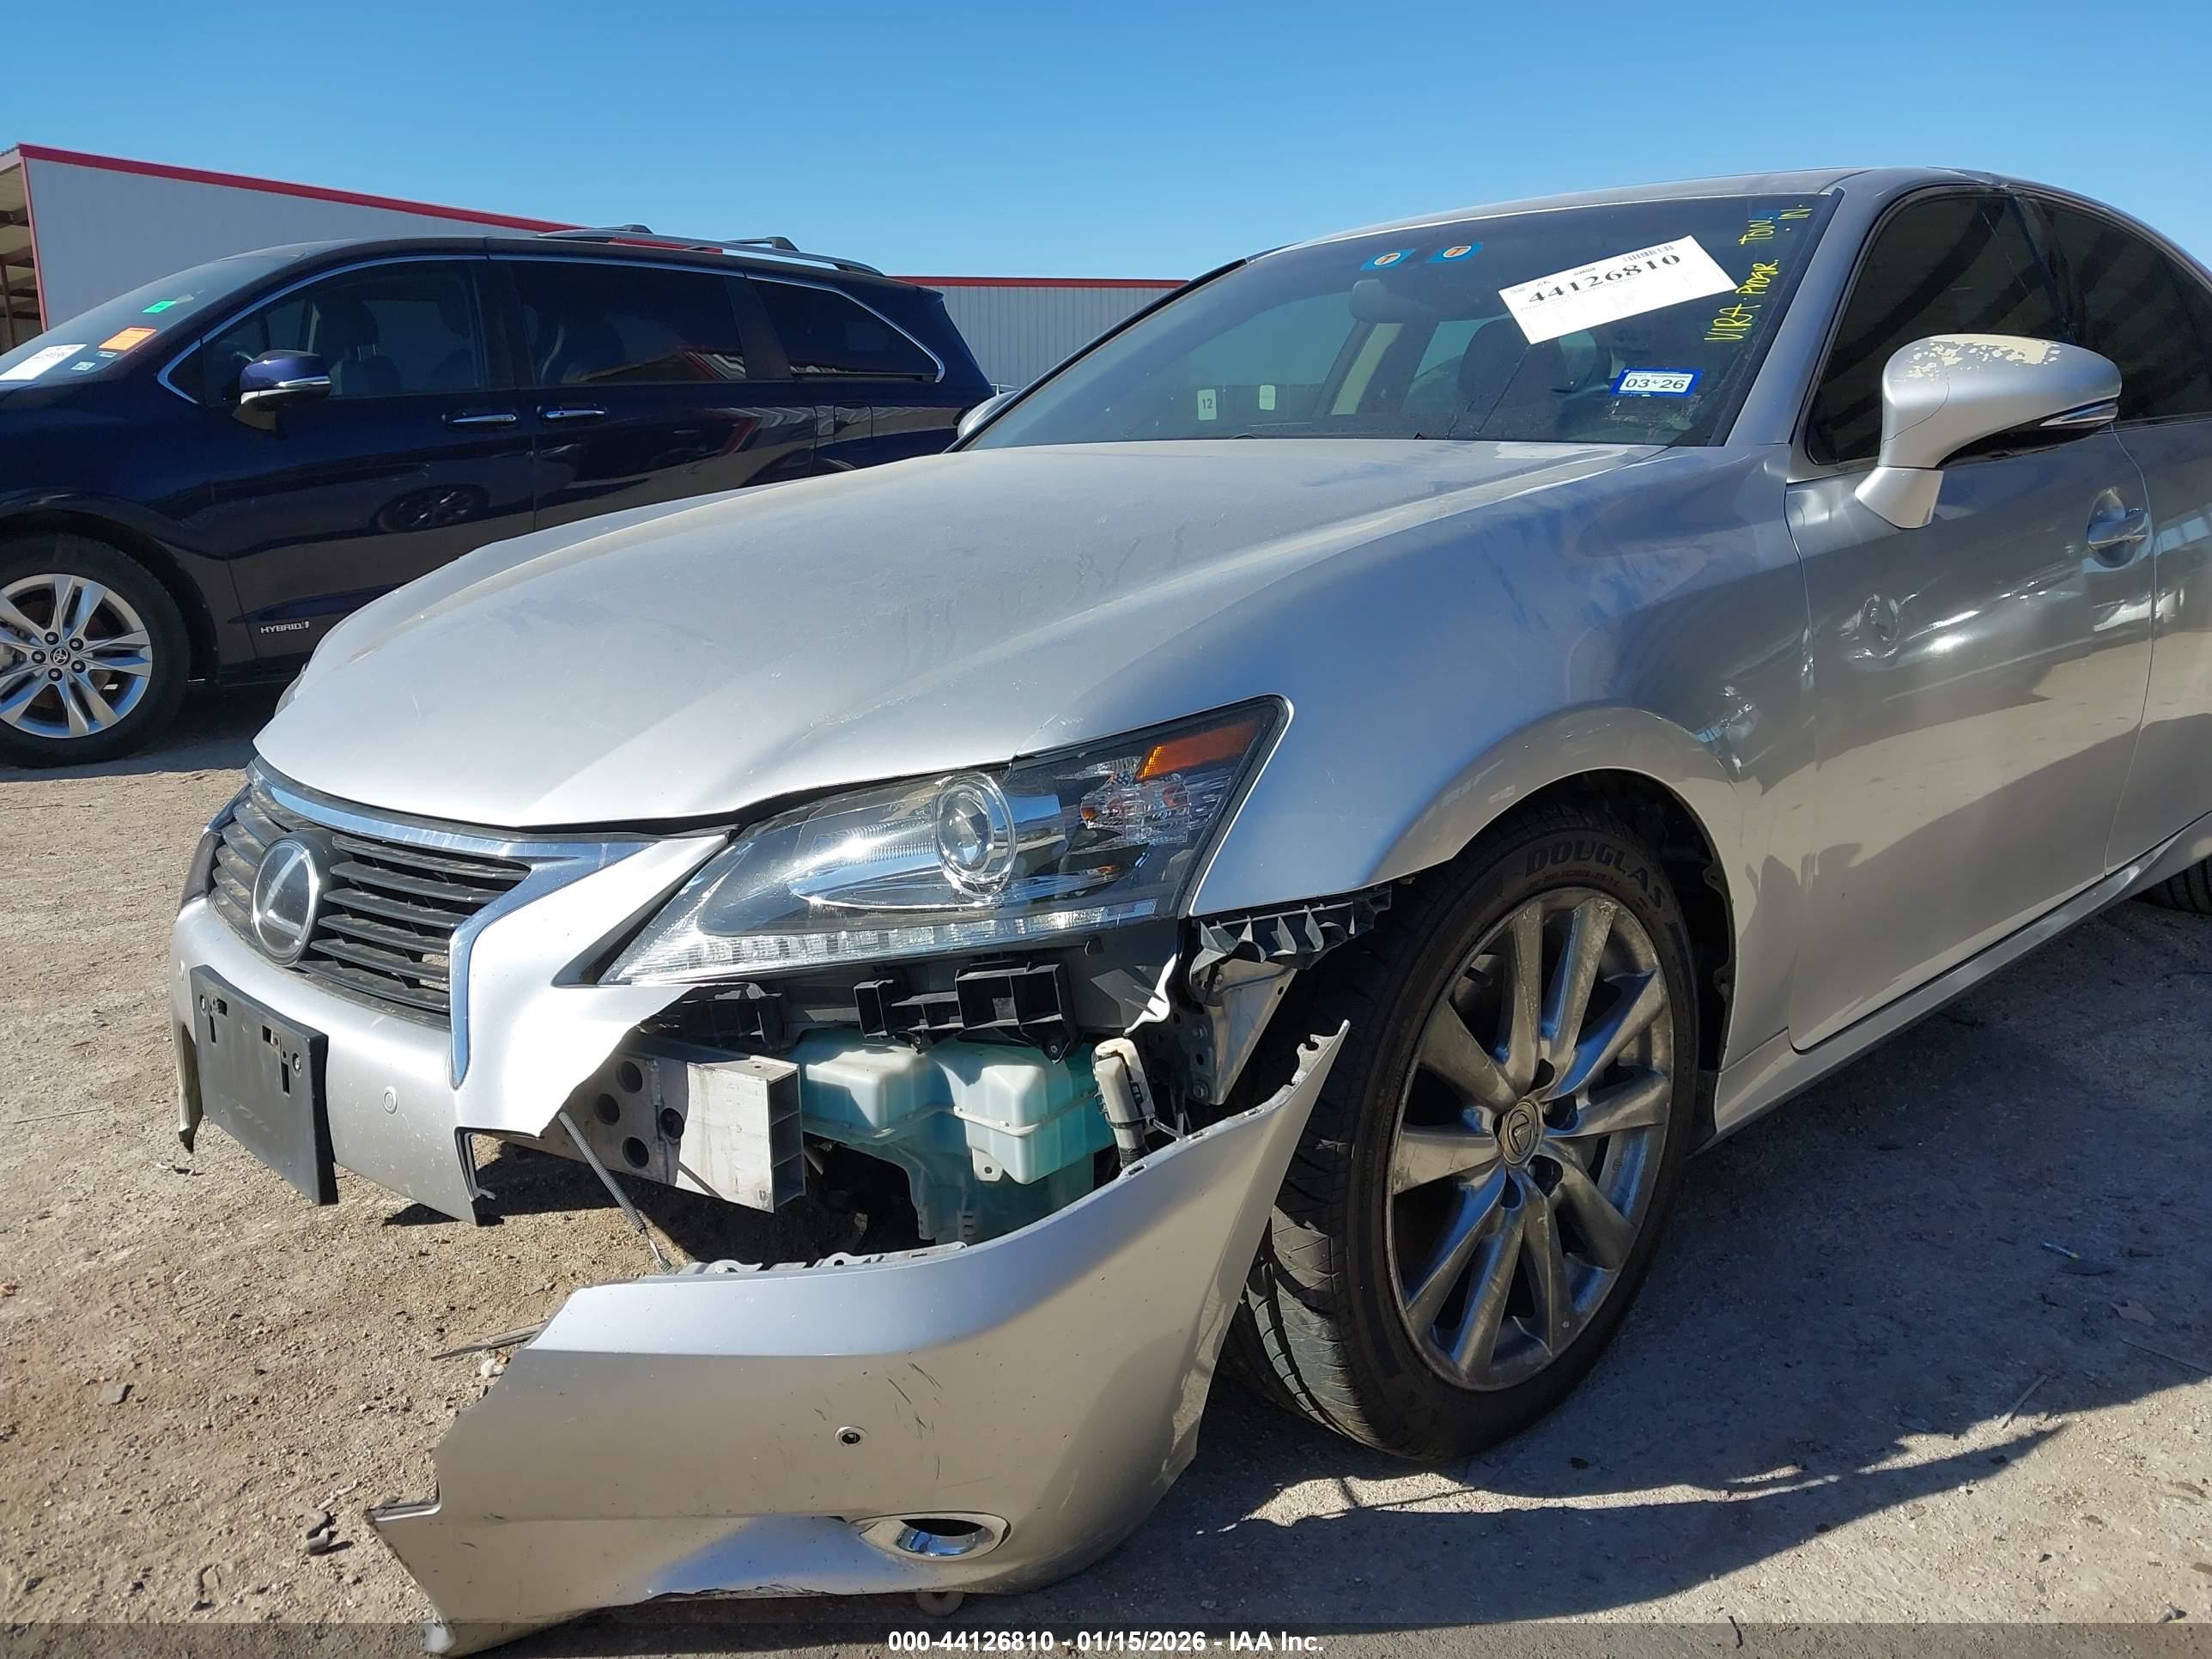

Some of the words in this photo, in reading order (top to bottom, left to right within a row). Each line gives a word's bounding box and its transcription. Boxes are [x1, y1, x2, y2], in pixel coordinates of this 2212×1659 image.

[1528, 254, 1680, 303] 44126810
[1201, 398, 1212, 410] 12
[260, 623, 302, 634] HYBRID
[1525, 839, 1662, 908] DOUGLAS
